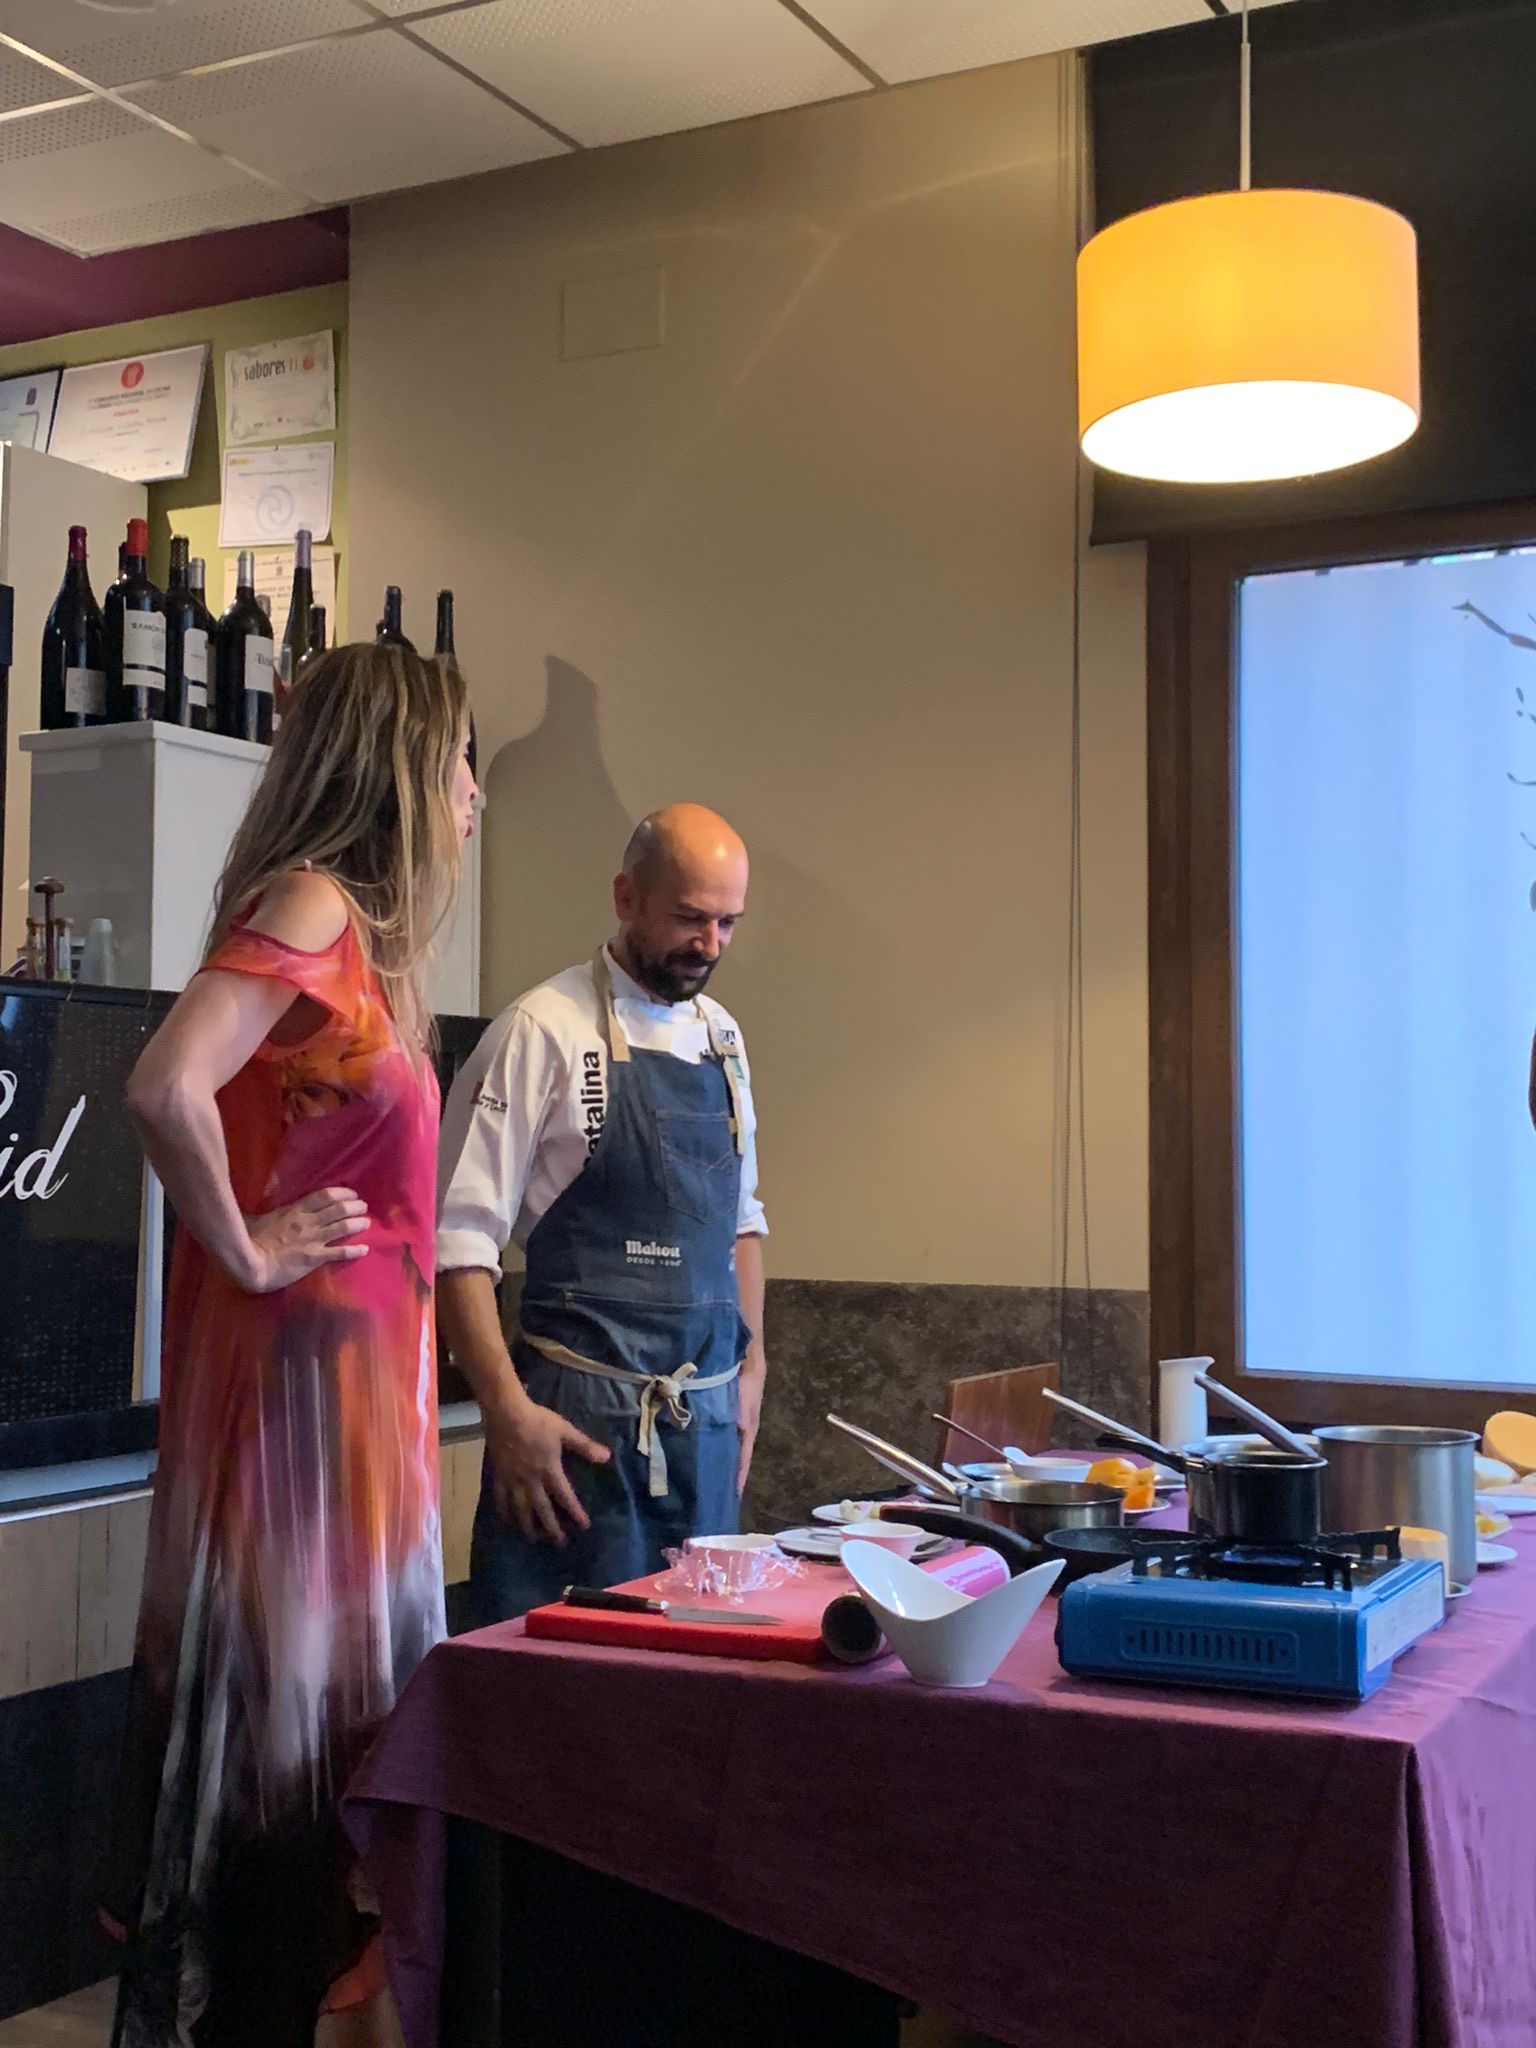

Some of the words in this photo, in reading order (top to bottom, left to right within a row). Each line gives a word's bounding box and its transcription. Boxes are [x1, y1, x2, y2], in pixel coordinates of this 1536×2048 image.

[244, 359, 286, 381] sabores
[580, 1051, 605, 1168] atalina
[625, 1240, 681, 1258] Mahou
